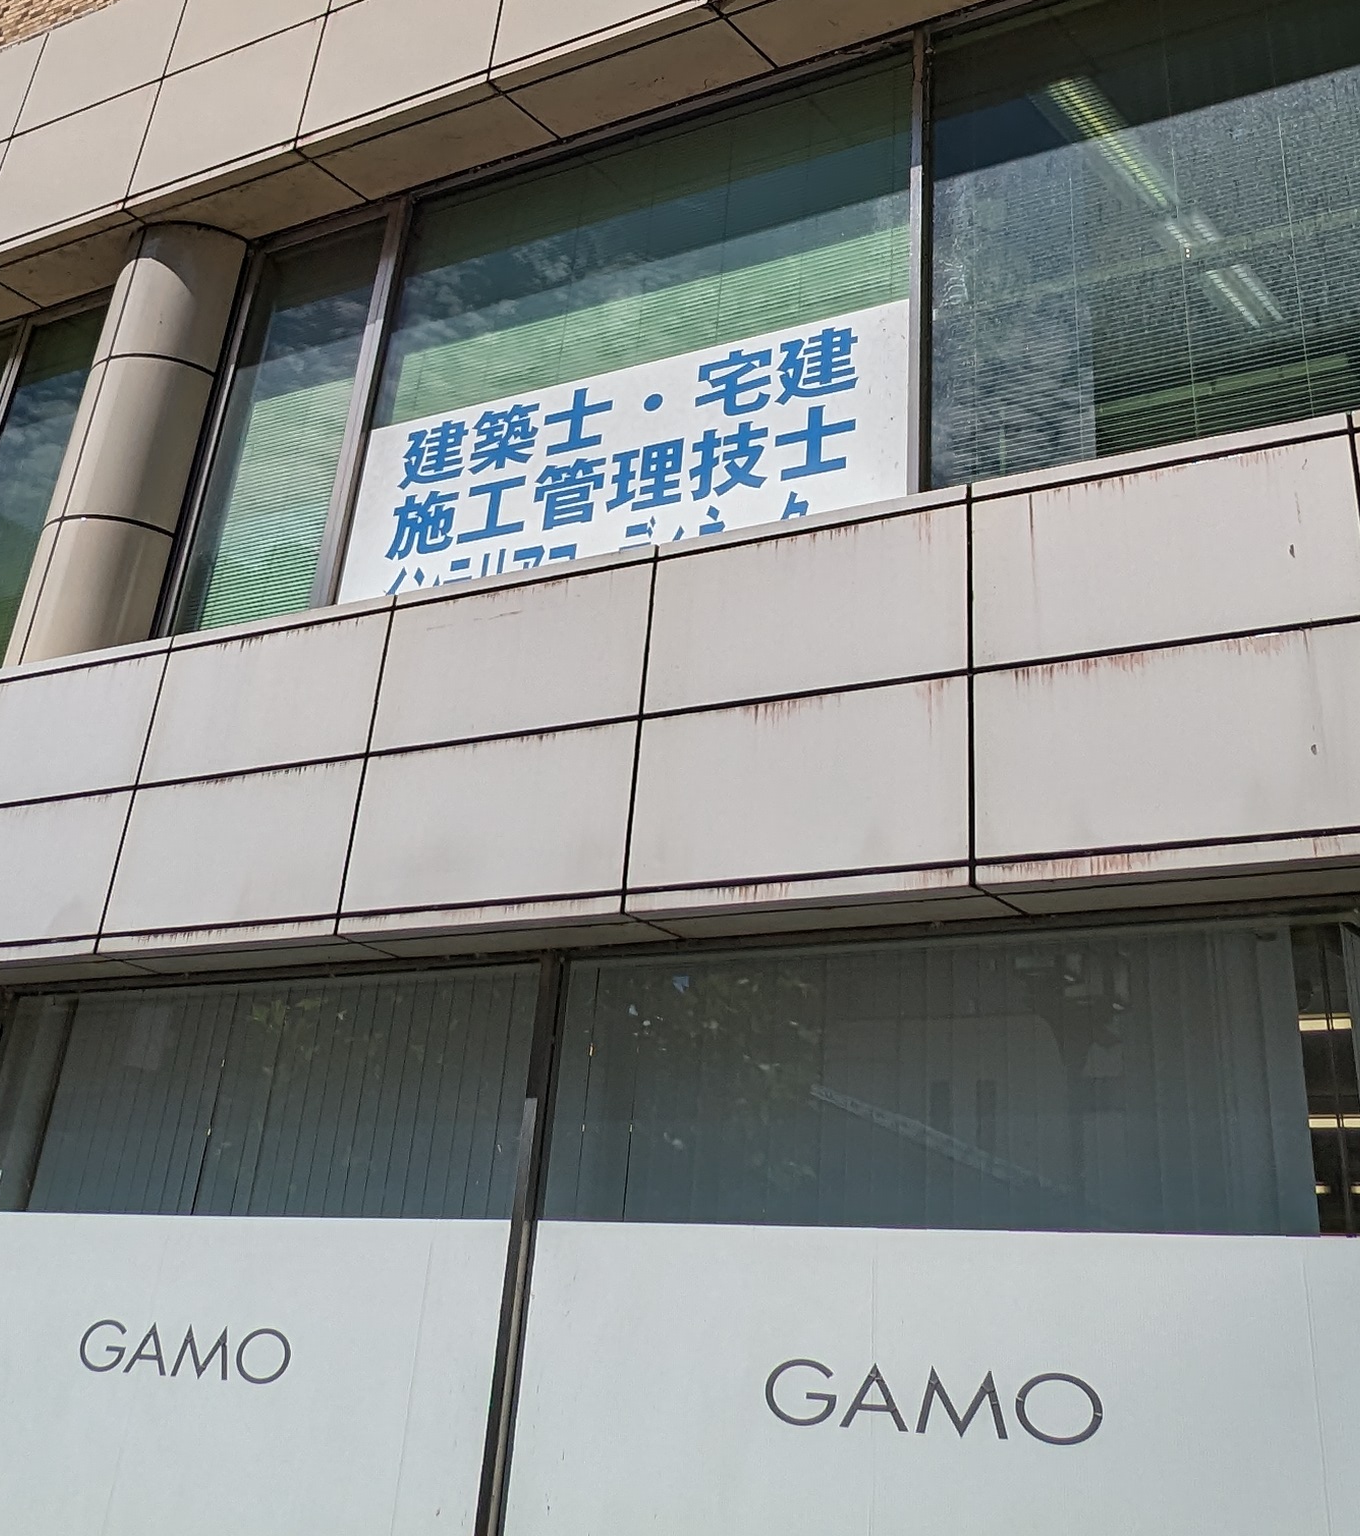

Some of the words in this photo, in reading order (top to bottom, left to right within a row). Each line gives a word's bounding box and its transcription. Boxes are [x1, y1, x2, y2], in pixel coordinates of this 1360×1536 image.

[397, 327, 859, 489] 建築士・宅建
[384, 404, 856, 561] 施工管理技士
[79, 1319, 292, 1385] GAMO
[764, 1358, 1104, 1446] GAMO
